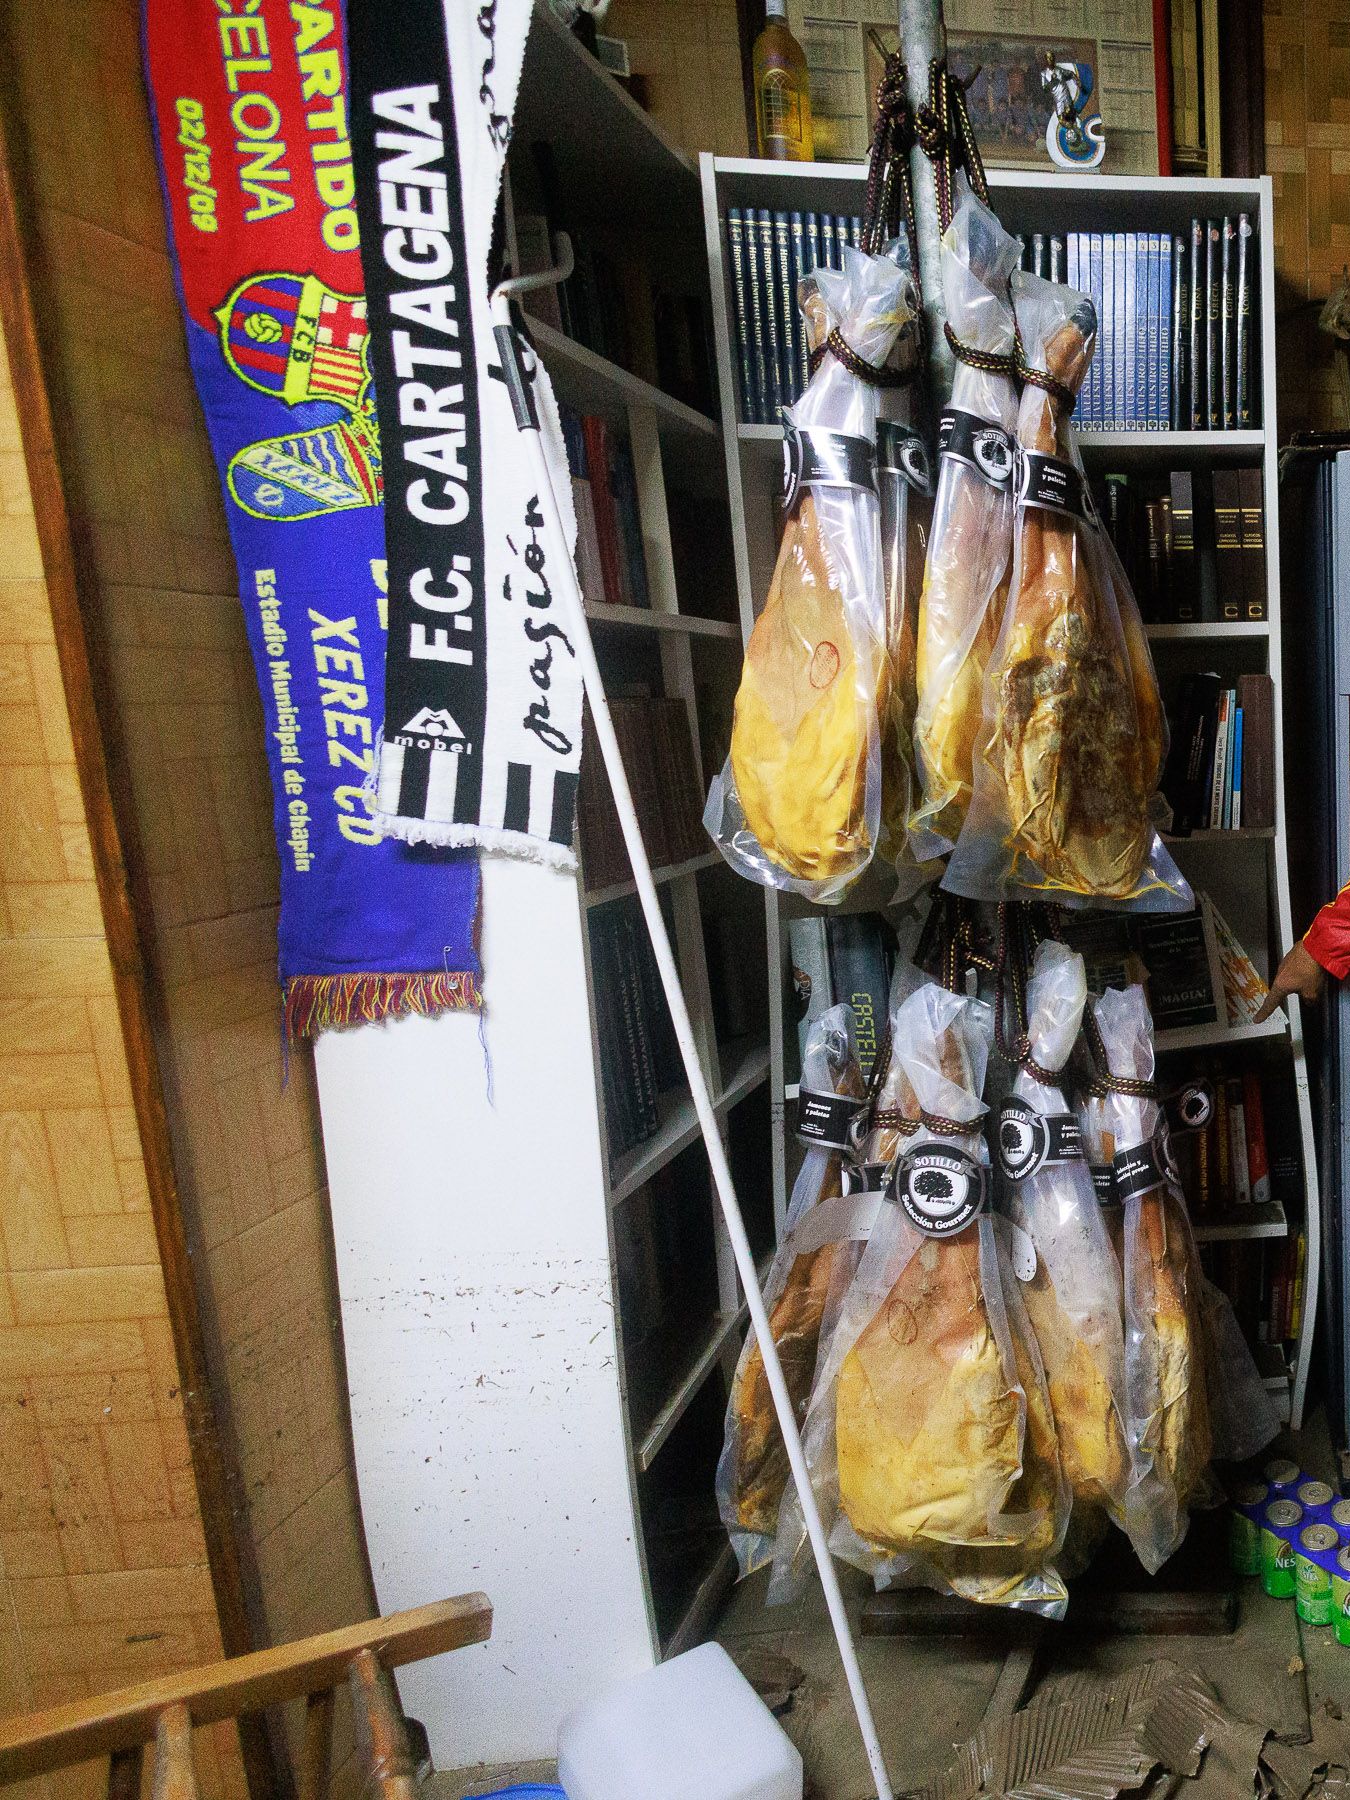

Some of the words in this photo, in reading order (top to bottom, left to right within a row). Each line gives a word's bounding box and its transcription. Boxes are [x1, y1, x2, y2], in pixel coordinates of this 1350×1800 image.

[290, 0, 361, 252] ARTIDO
[175, 97, 218, 233] 02/12/09
[372, 83, 470, 526] CARTAGENA
[1210, 281, 1219, 320] GRECIA
[292, 313, 319, 366] FCB
[255, 569, 288, 657] Estadio
[409, 554, 474, 666] F.C.
[268, 660, 304, 764] Municipal
[308, 607, 374, 774] XEREZ
[394, 734, 473, 755] mobel
[283, 769, 306, 796] de
[333, 785, 383, 846] CD
[914, 1155, 963, 1171] SOTILLO
[1014, 1152, 1039, 1180] Gourmet
[901, 1193, 934, 1230] Selección
[934, 1203, 974, 1230] Gourmet
[1275, 1557, 1296, 1569] NES
